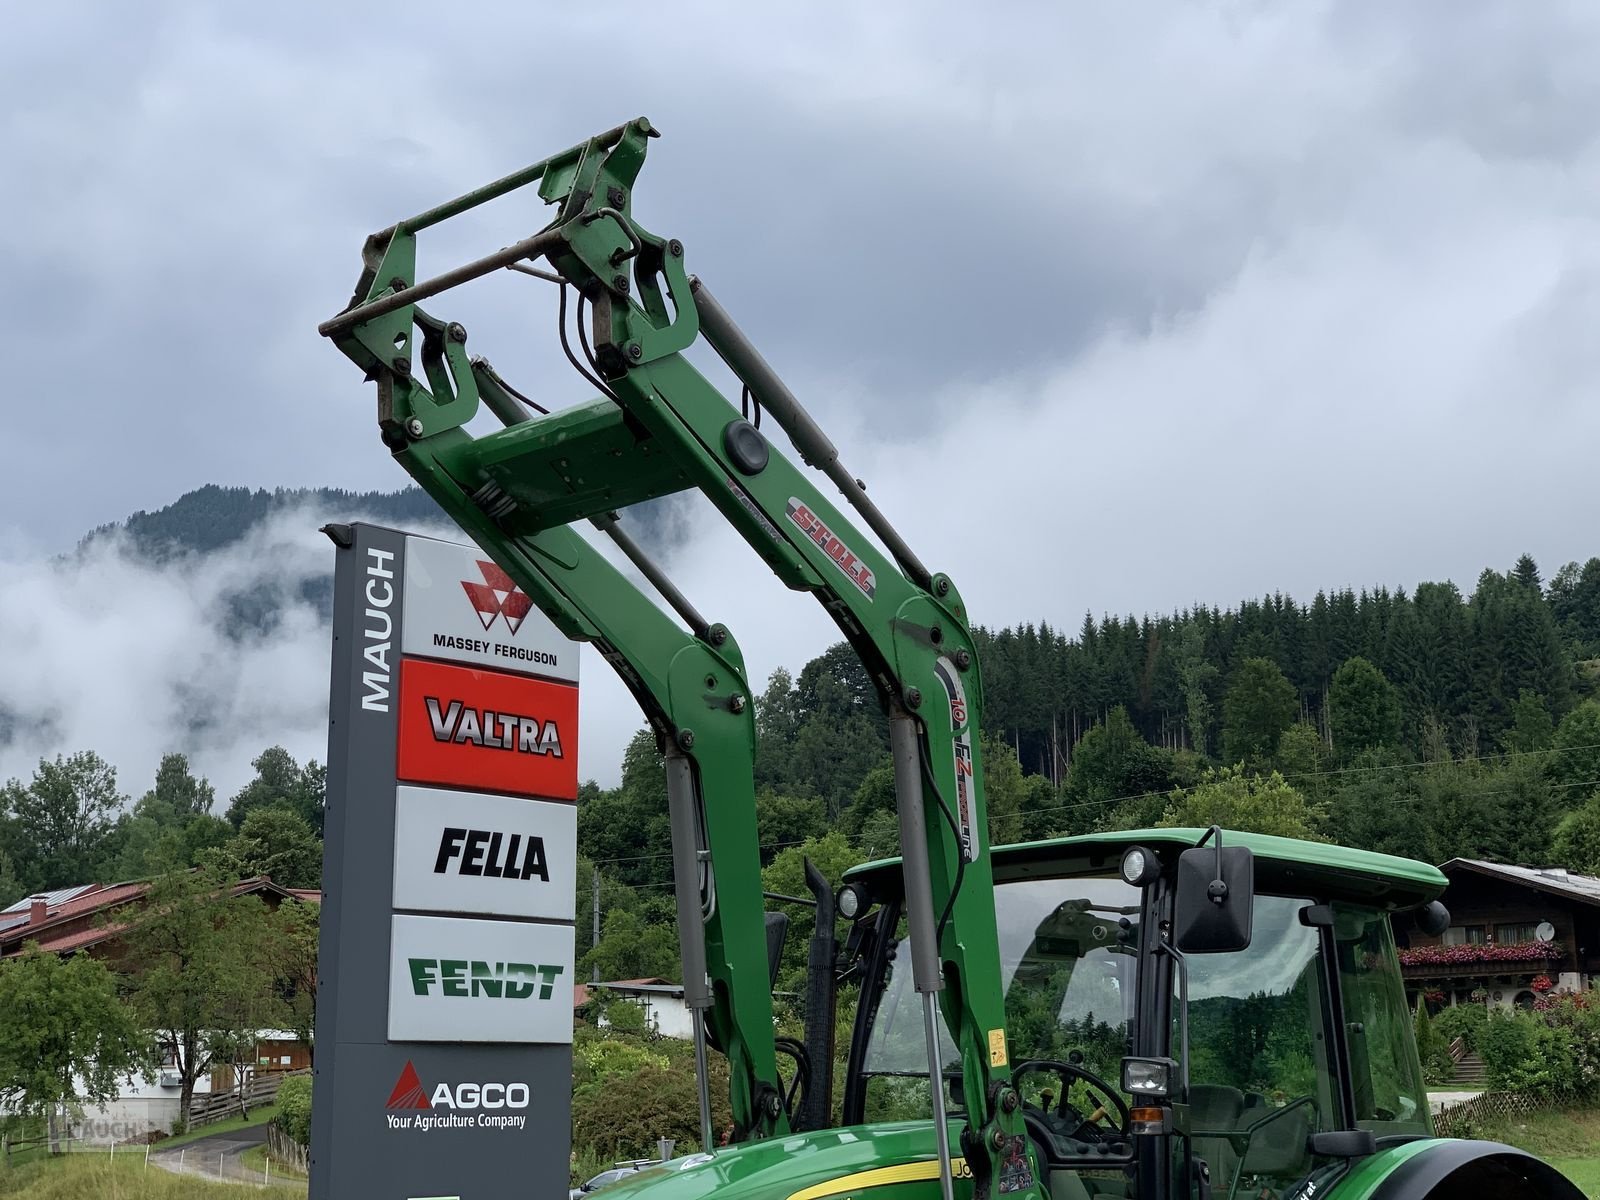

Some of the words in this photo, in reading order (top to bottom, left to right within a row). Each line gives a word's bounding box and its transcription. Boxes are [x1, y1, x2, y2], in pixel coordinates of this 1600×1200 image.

[791, 505, 873, 592] STOLL
[361, 547, 394, 712] MAUCH
[433, 633, 490, 654] MASSEY
[494, 643, 558, 666] FERGUSON
[424, 695, 563, 758] VALTRA
[433, 827, 550, 882] FELLA
[408, 957, 564, 1000] FENDT
[430, 1083, 530, 1109] AGCO
[386, 1114, 412, 1128] Your
[414, 1113, 475, 1131] Agriculture
[477, 1113, 526, 1130] Company
